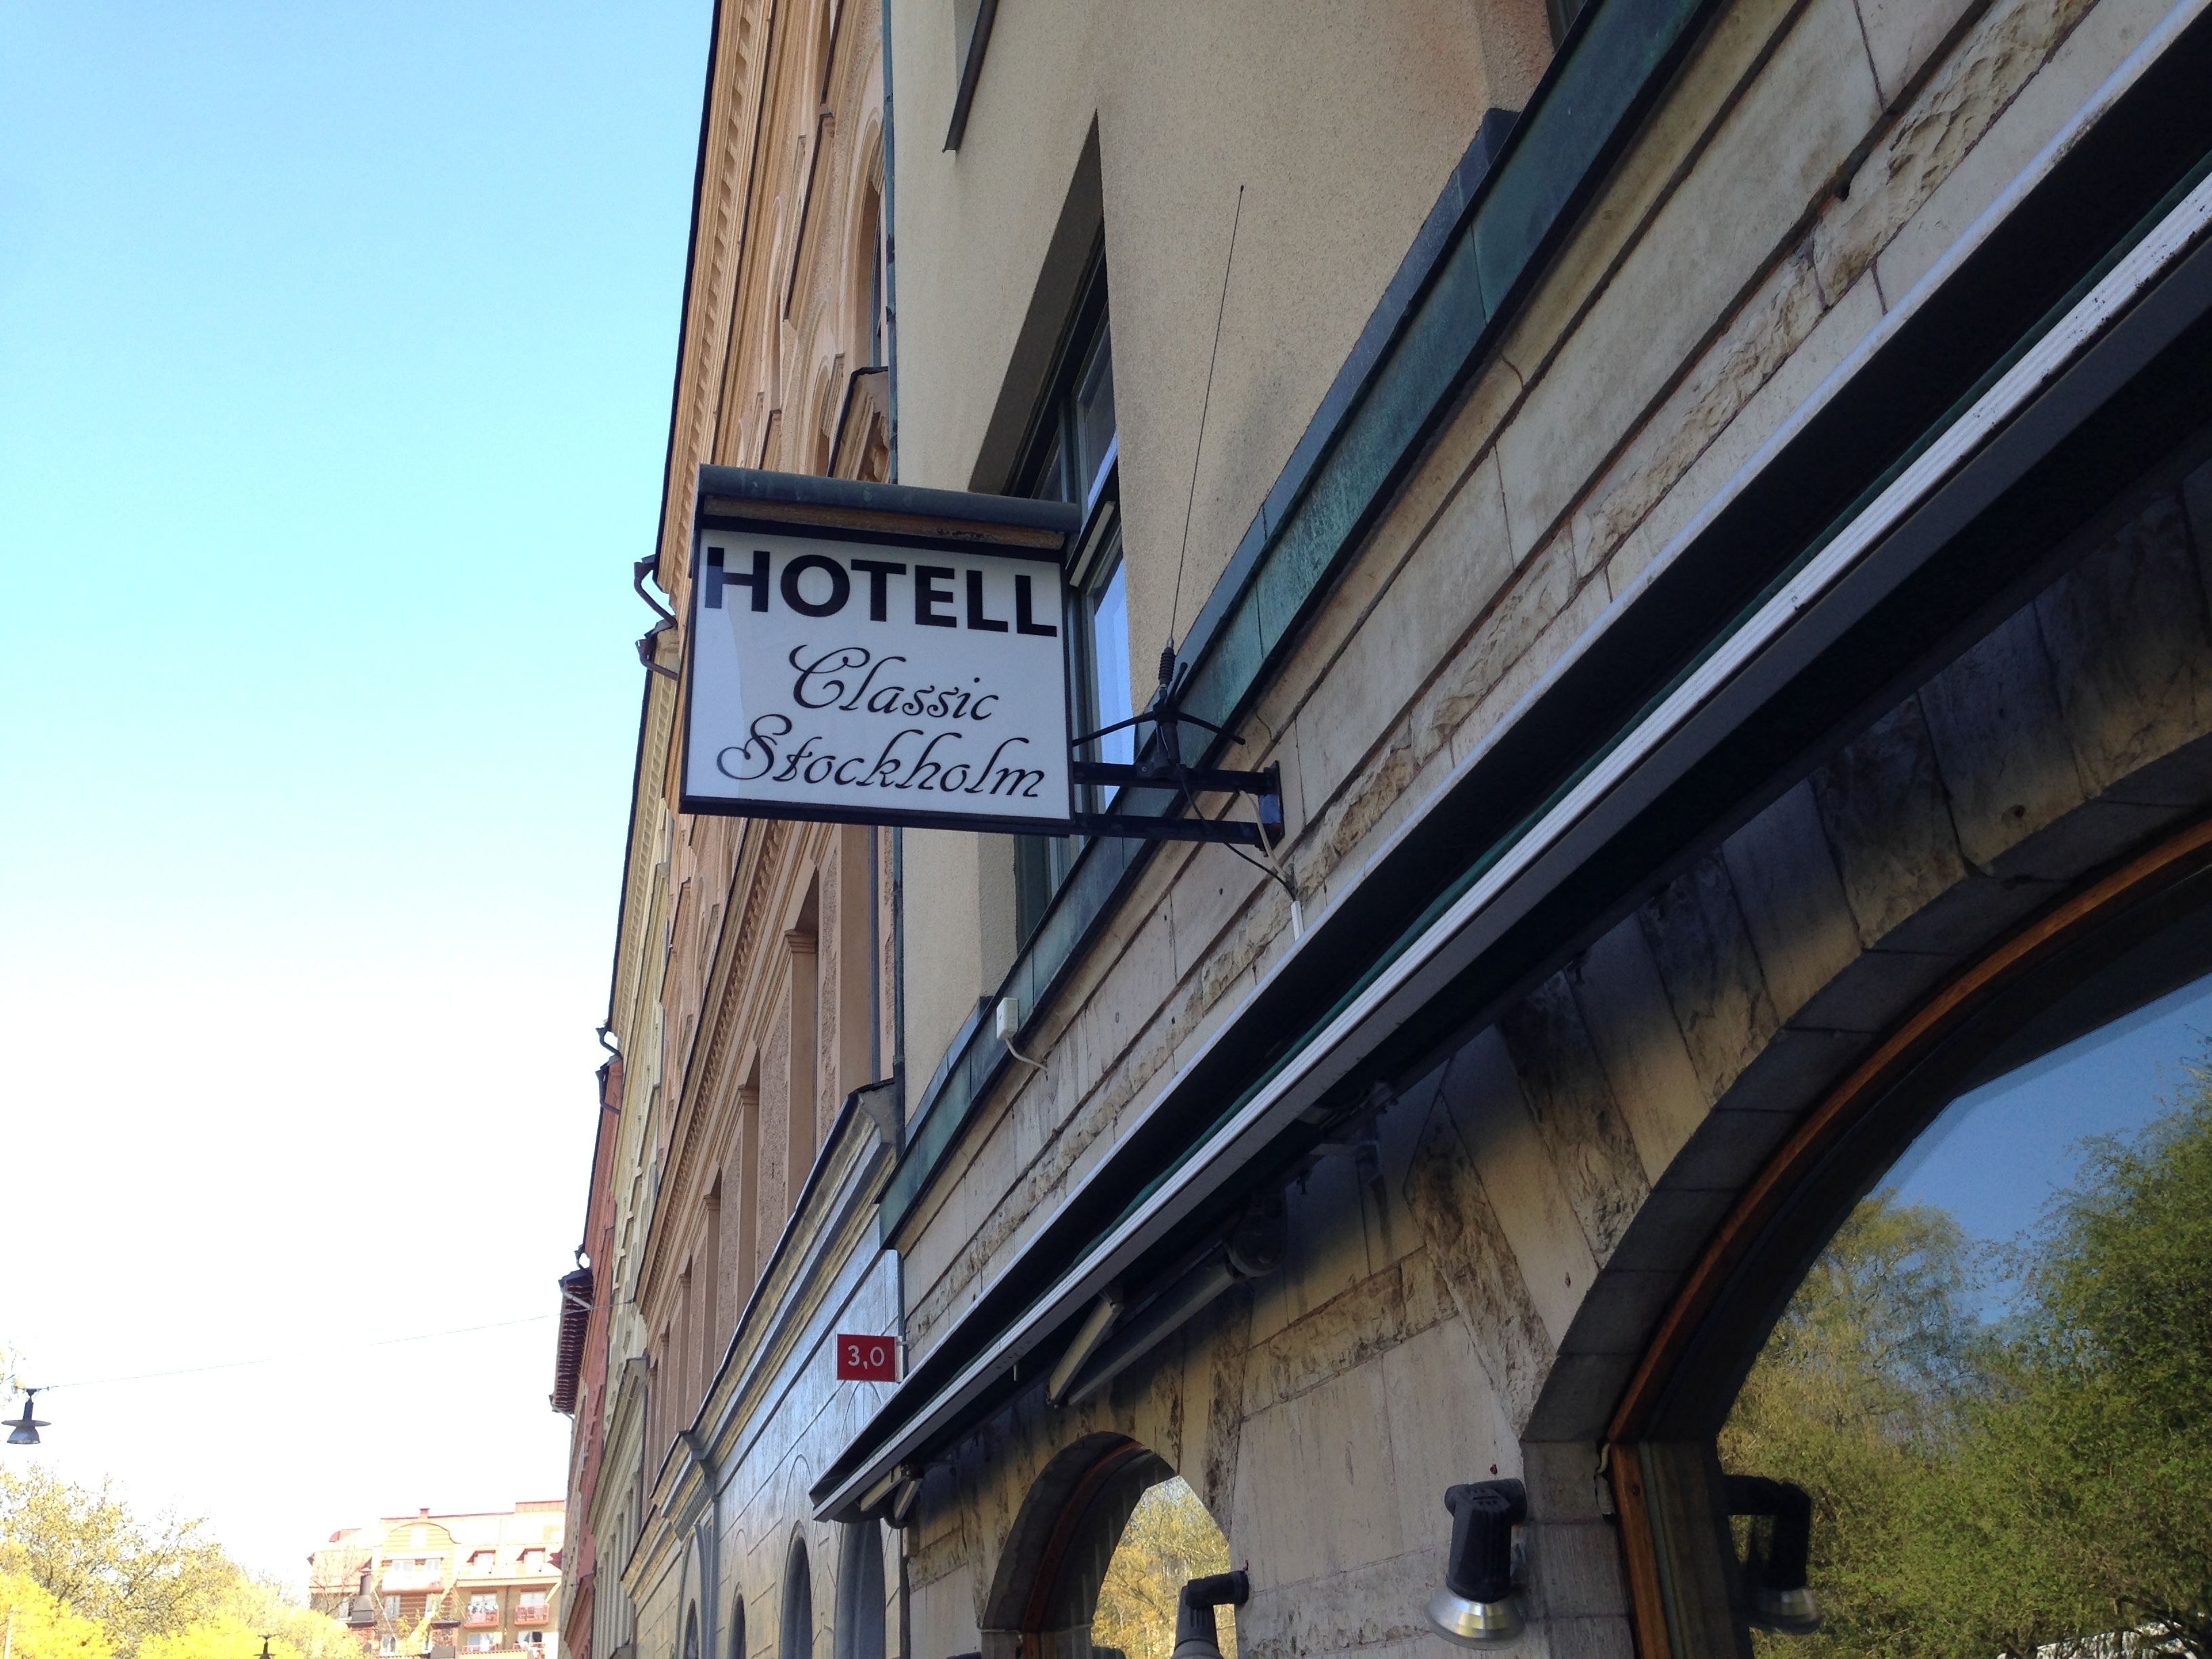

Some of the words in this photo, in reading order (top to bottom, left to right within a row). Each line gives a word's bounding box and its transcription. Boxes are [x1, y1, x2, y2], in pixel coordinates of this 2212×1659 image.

[704, 546, 1057, 637] HOTELL
[789, 644, 999, 721] Classic
[716, 714, 1044, 798] Stockholm
[847, 1345, 885, 1370] 3,0
